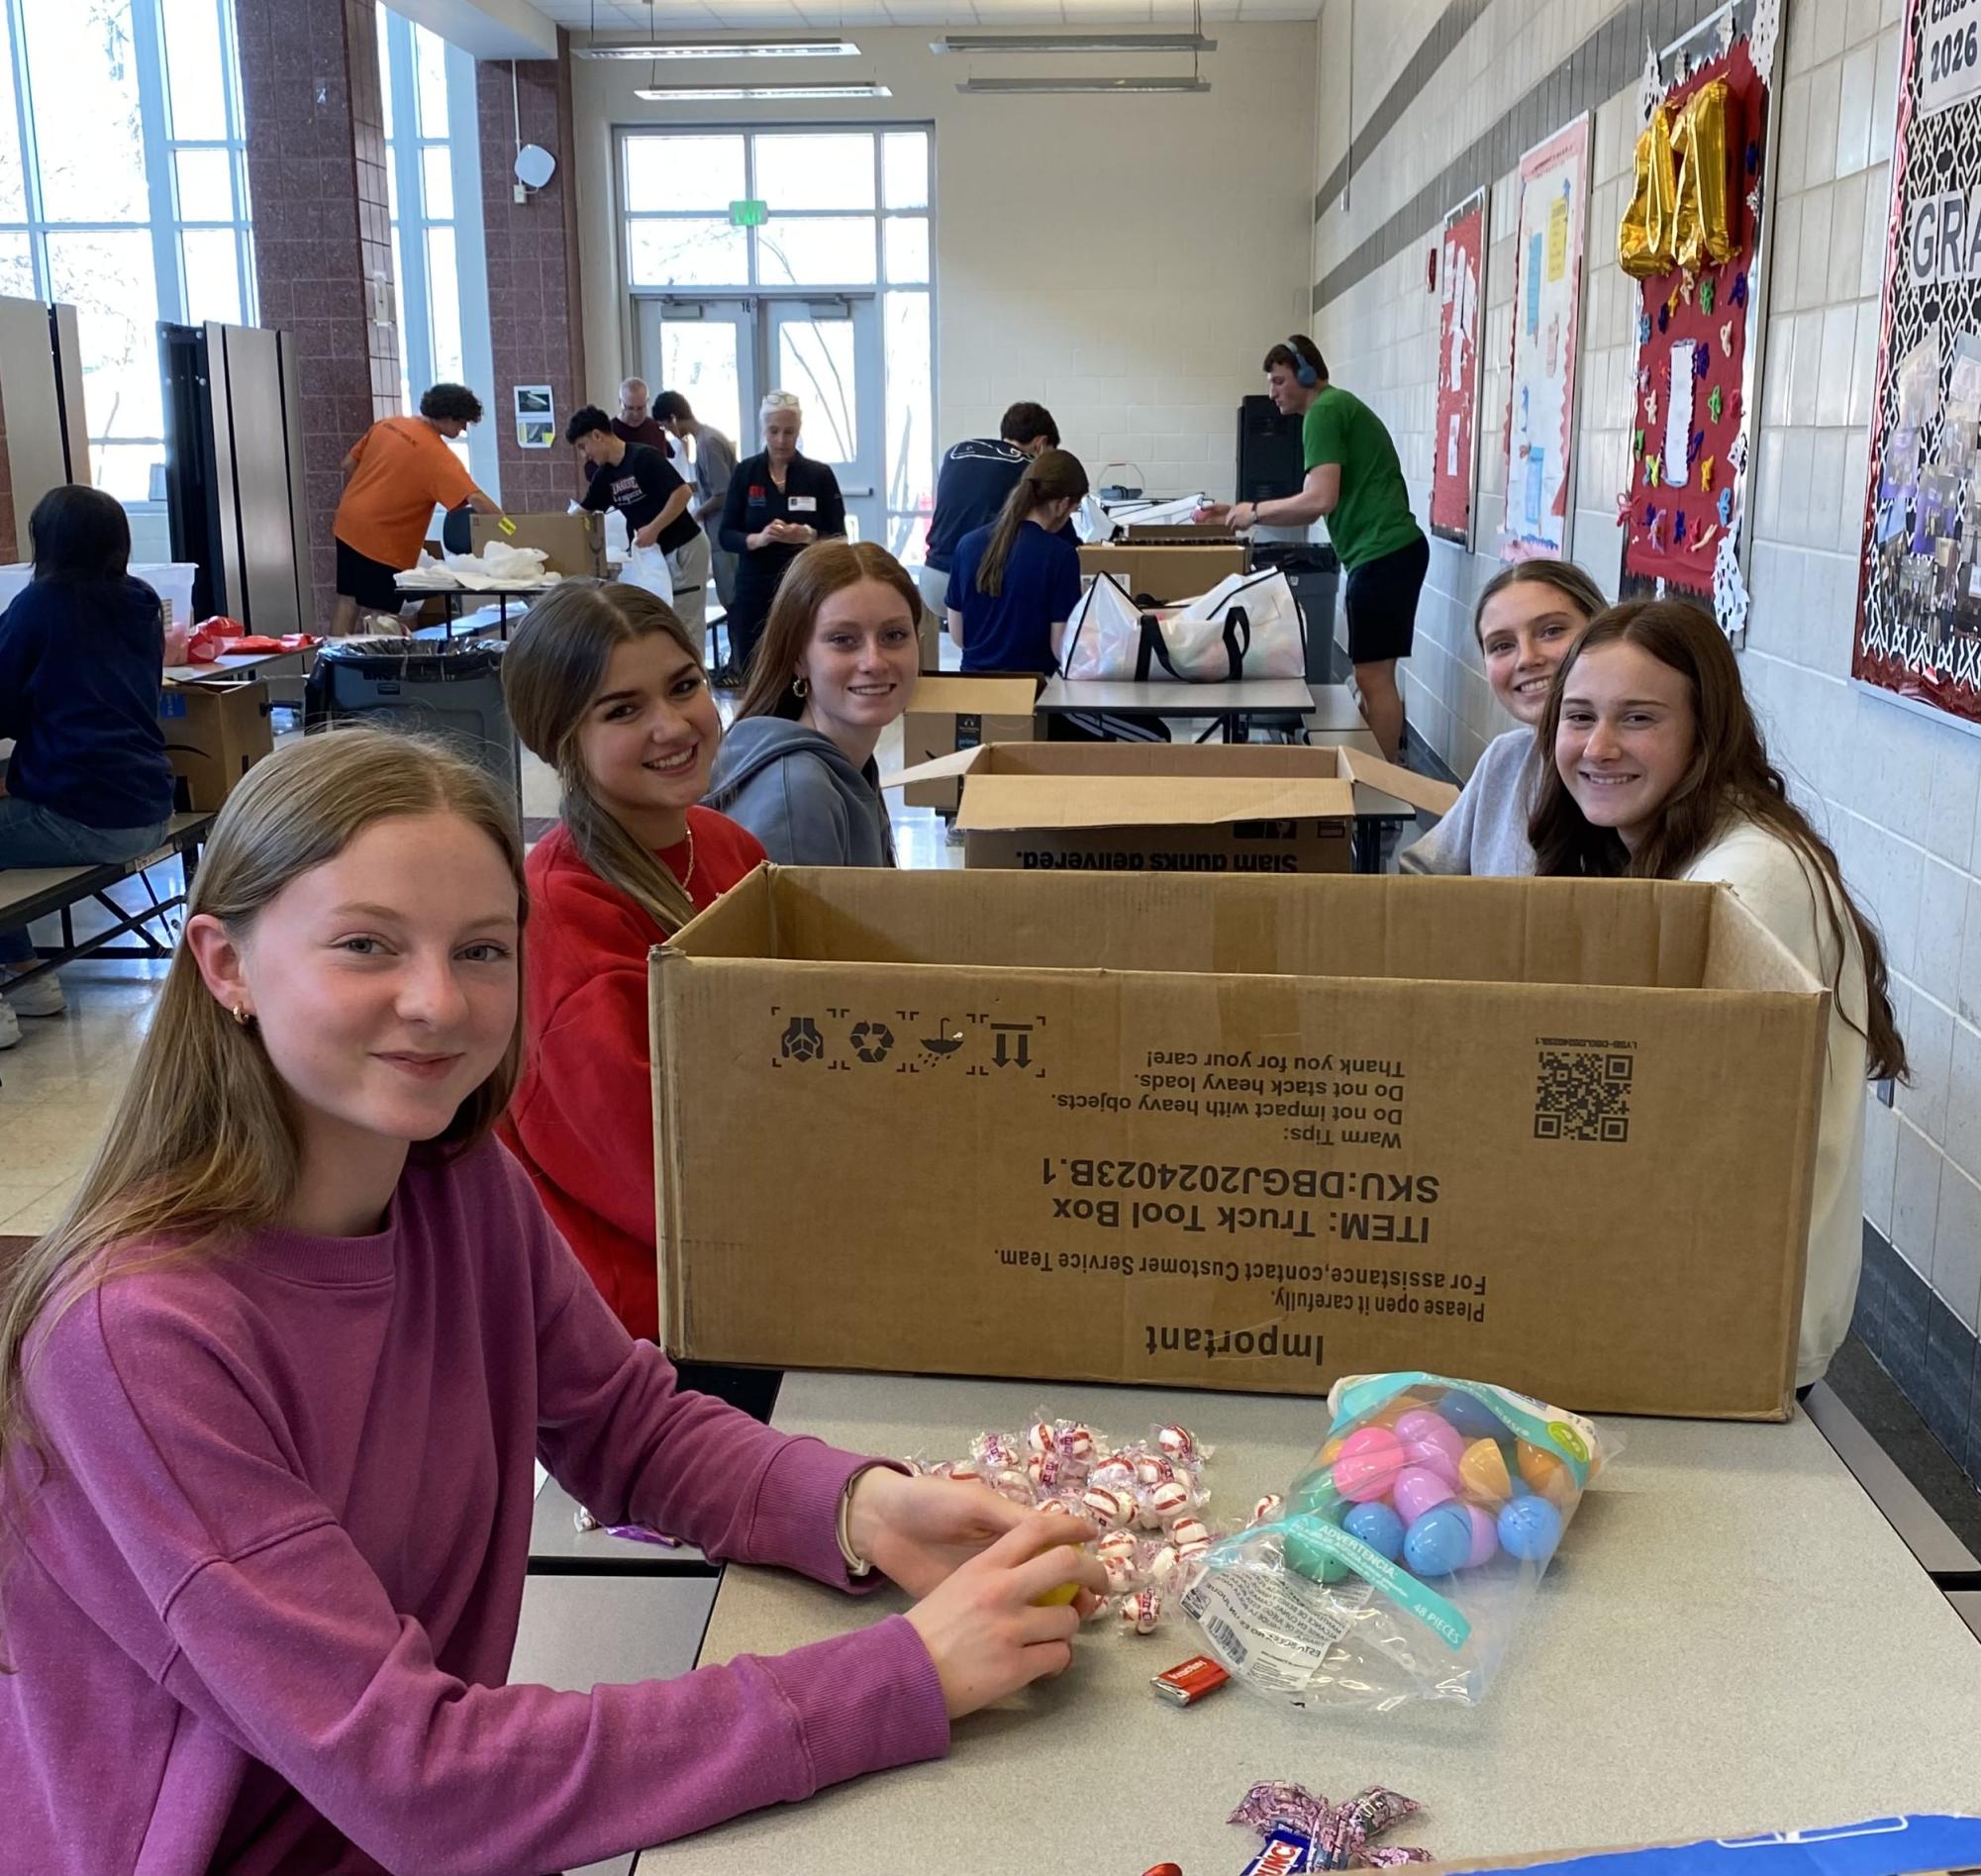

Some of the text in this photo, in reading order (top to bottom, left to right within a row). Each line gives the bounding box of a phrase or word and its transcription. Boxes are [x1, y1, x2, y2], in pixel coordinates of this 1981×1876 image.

[1931, 21, 1977, 83] 2026
[1147, 1051, 1405, 1077] Thank you for your care!
[1135, 1073, 1403, 1102] Do not stack heavy loads.
[1052, 1093, 1402, 1125] Do not impact with heavy objects.
[1284, 1125, 1401, 1148] Warm Tips:
[1043, 1158, 1439, 1203] SKU:DBGJ2024023B.1
[1053, 1199, 1429, 1243] ITEM: Truck Tool Box
[995, 1250, 1052, 1271] Team.
[1058, 1253, 1134, 1275] Service
[1139, 1257, 1238, 1282] Customer
[1450, 1275, 1486, 1295] For
[1271, 1287, 1484, 1323] Please open it carefully.
[1146, 1326, 1323, 1365] Important
[1413, 1604, 1460, 1645] 48 PIECES
